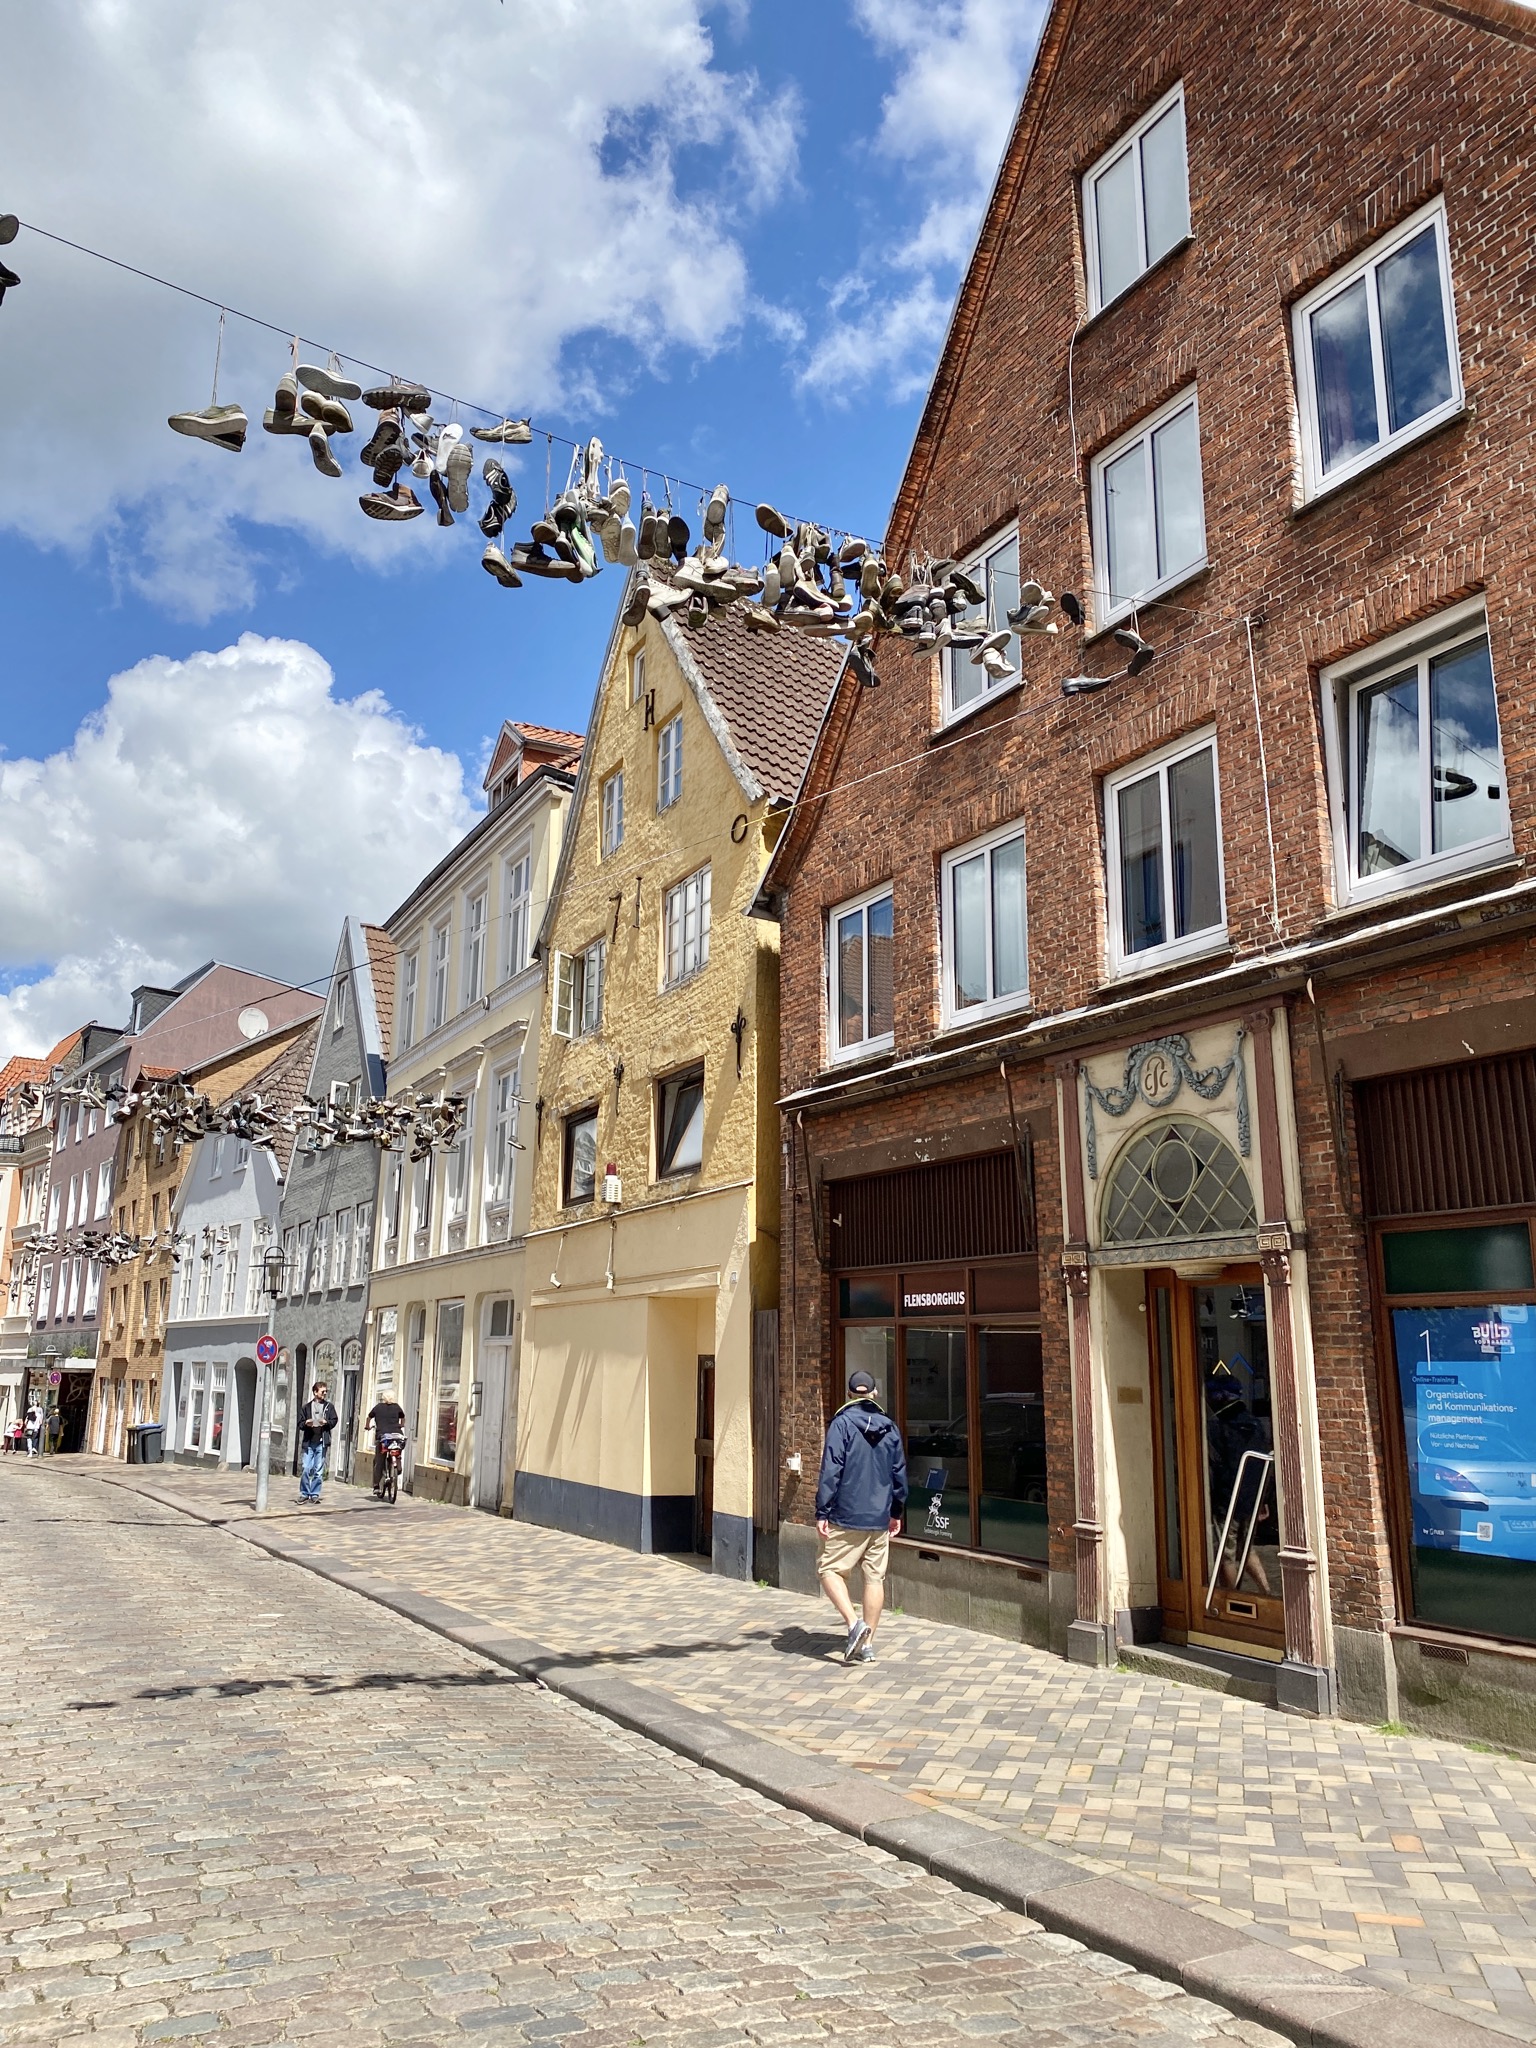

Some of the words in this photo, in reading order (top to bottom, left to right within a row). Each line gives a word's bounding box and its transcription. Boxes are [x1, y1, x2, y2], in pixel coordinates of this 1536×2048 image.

[904, 1291, 966, 1308] FLENSBORGHUS
[1471, 1320, 1510, 1339] BUILD
[1419, 1329, 1432, 1372] 1
[1411, 1375, 1456, 1385] Online-Training
[1425, 1389, 1487, 1401] Organisations-
[1427, 1401, 1443, 1411] und
[1444, 1401, 1518, 1413] Kommunikations-
[1428, 1414, 1483, 1425] management
[1429, 1432, 1455, 1440] Nützliche
[1443, 1441, 1454, 1449] und
[935, 1515, 950, 1530] SSF
